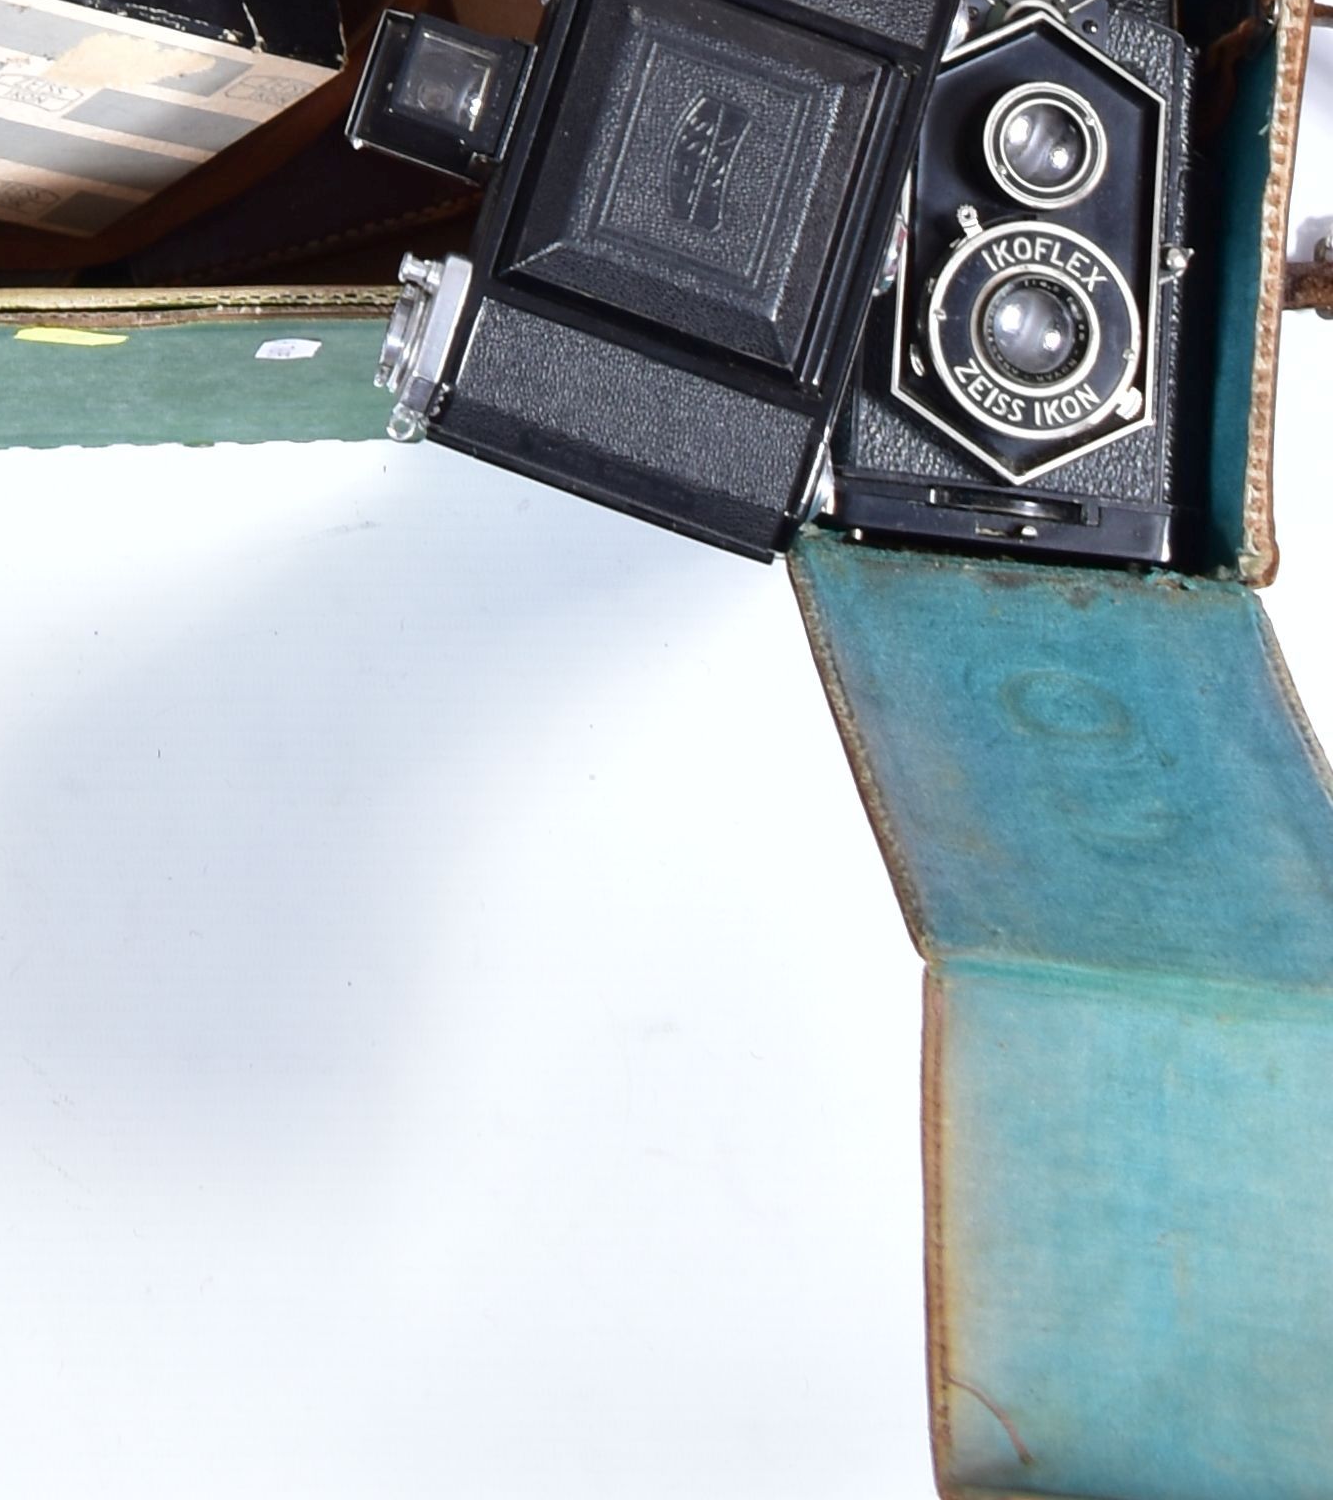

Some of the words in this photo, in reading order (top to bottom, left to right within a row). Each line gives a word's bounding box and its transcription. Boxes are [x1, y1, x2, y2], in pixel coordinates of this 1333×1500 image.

[981, 237, 1108, 292] IKOFLEX
[954, 357, 1026, 422] ZEISS
[1034, 382, 1101, 426] IKON
